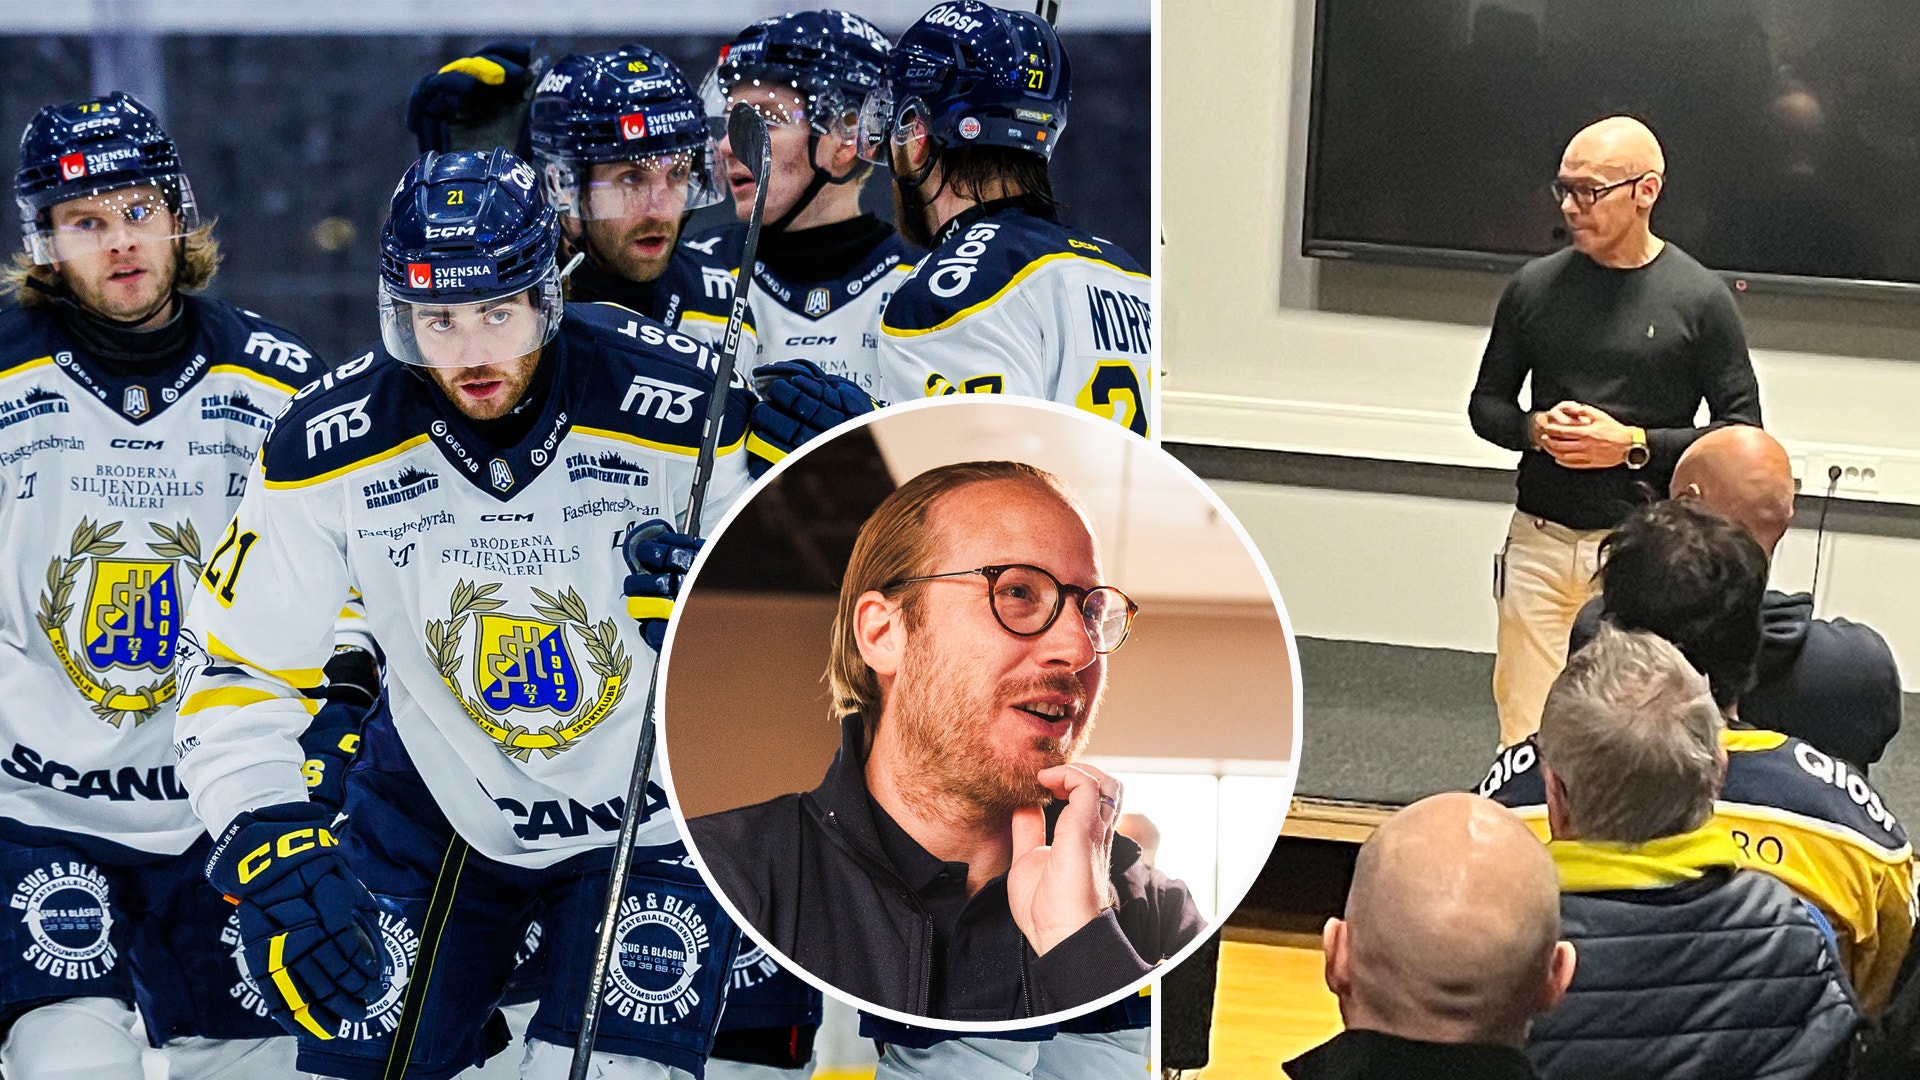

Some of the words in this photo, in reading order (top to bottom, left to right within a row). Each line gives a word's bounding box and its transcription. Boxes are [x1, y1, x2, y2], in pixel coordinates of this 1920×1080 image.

[925, 5, 983, 34] Qlosr
[628, 61, 648, 73] 45
[905, 68, 937, 78] CCM
[628, 79, 671, 94] CCM
[1028, 69, 1044, 89] 27
[78, 103, 101, 114] 72
[647, 110, 695, 125] SVENSKA
[72, 117, 120, 133] CCM
[649, 123, 676, 136] SPEL
[87, 148, 140, 166] SVENSKA
[89, 161, 118, 175] SPEL
[447, 190, 464, 205] 21
[426, 226, 477, 239] CCM
[435, 265, 491, 278] SVENSKA
[435, 278, 465, 288] SPEL
[727, 302, 743, 351] CCM
[785, 336, 837, 346] CCM
[244, 332, 312, 373] m3
[619, 375, 705, 424] m3
[305, 394, 372, 460] m3
[555, 412, 568, 430] AB
[110, 439, 164, 450] CCM
[445, 435, 466, 458] GEO
[463, 457, 479, 473] AB
[566, 452, 589, 469] STÅL
[590, 454, 598, 466] &
[96, 465, 177, 479] BRÖDERNA
[569, 467, 630, 486] BRANDTEKNIK
[633, 474, 649, 487] AB
[70, 477, 204, 496] SILJENDAHLS
[363, 480, 388, 497] STÅL
[389, 479, 398, 490] &
[108, 493, 164, 508] MÅLERI
[480, 512, 535, 522] CCM
[470, 534, 554, 549] BRÖDERNA
[441, 546, 581, 568] SILJENDAHLS
[572, 685, 617, 734] SPORTKLUBB
[1, 743, 190, 801] SCANI
[1479, 744, 1536, 798] Qlo
[1794, 742, 1897, 832] Qlosr
[492, 780, 671, 841] CANIA
[229, 824, 240, 836] SK
[17, 868, 49, 895] SUG
[51, 862, 65, 878] &
[619, 896, 641, 921] UG
[646, 892, 658, 909] &
[663, 895, 710, 953] BLÅSBIL
[618, 914, 695, 955] MATERIALBLÅSNING
[621, 942, 640, 953] SUG
[642, 946, 649, 954] &
[651, 946, 685, 960] BLÅSBIL
[622, 954, 668, 965] SVERIGE
[621, 960, 636, 968] 08
[638, 962, 653, 970] 39
[613, 968, 684, 1001] VACUUMSUGNING
[604, 976, 701, 1026] SUGBIL.NU
